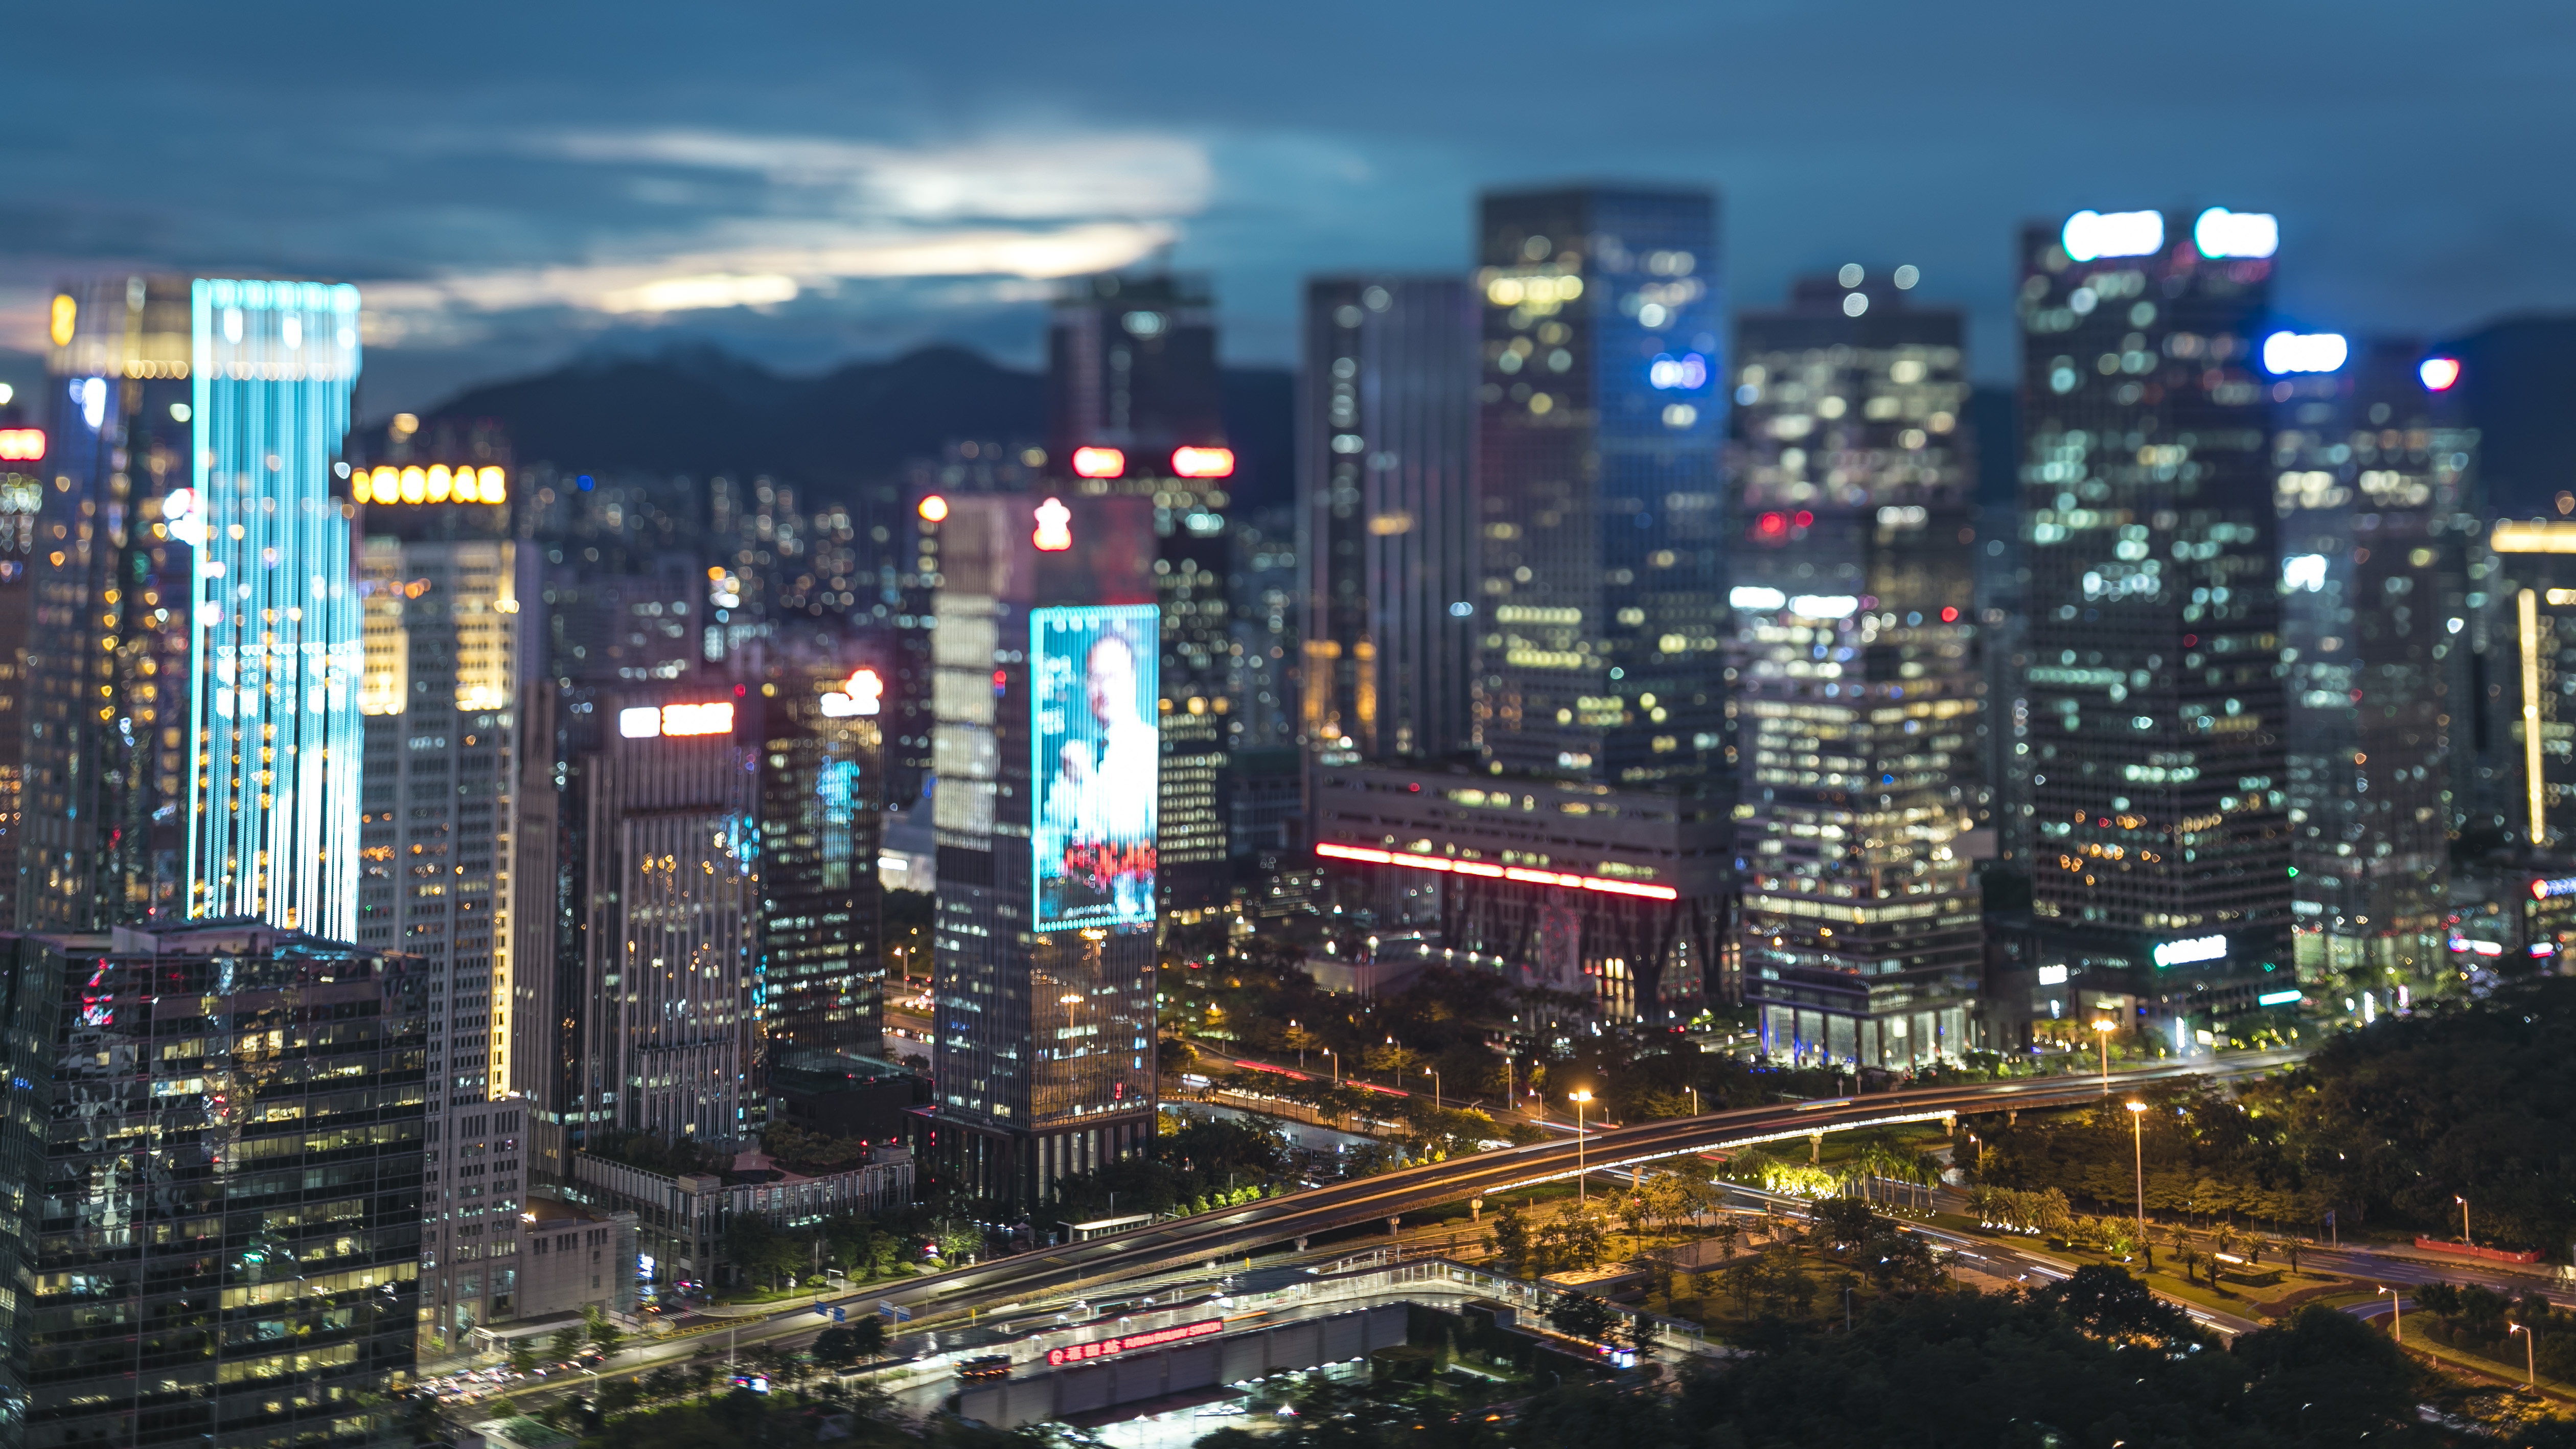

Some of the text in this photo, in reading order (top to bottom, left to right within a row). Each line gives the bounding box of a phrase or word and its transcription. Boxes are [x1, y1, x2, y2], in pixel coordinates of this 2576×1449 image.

[1123, 1321, 1222, 1349] FUTIAN RAILWAY STATION
[1065, 1339, 1121, 1361] 福田站
